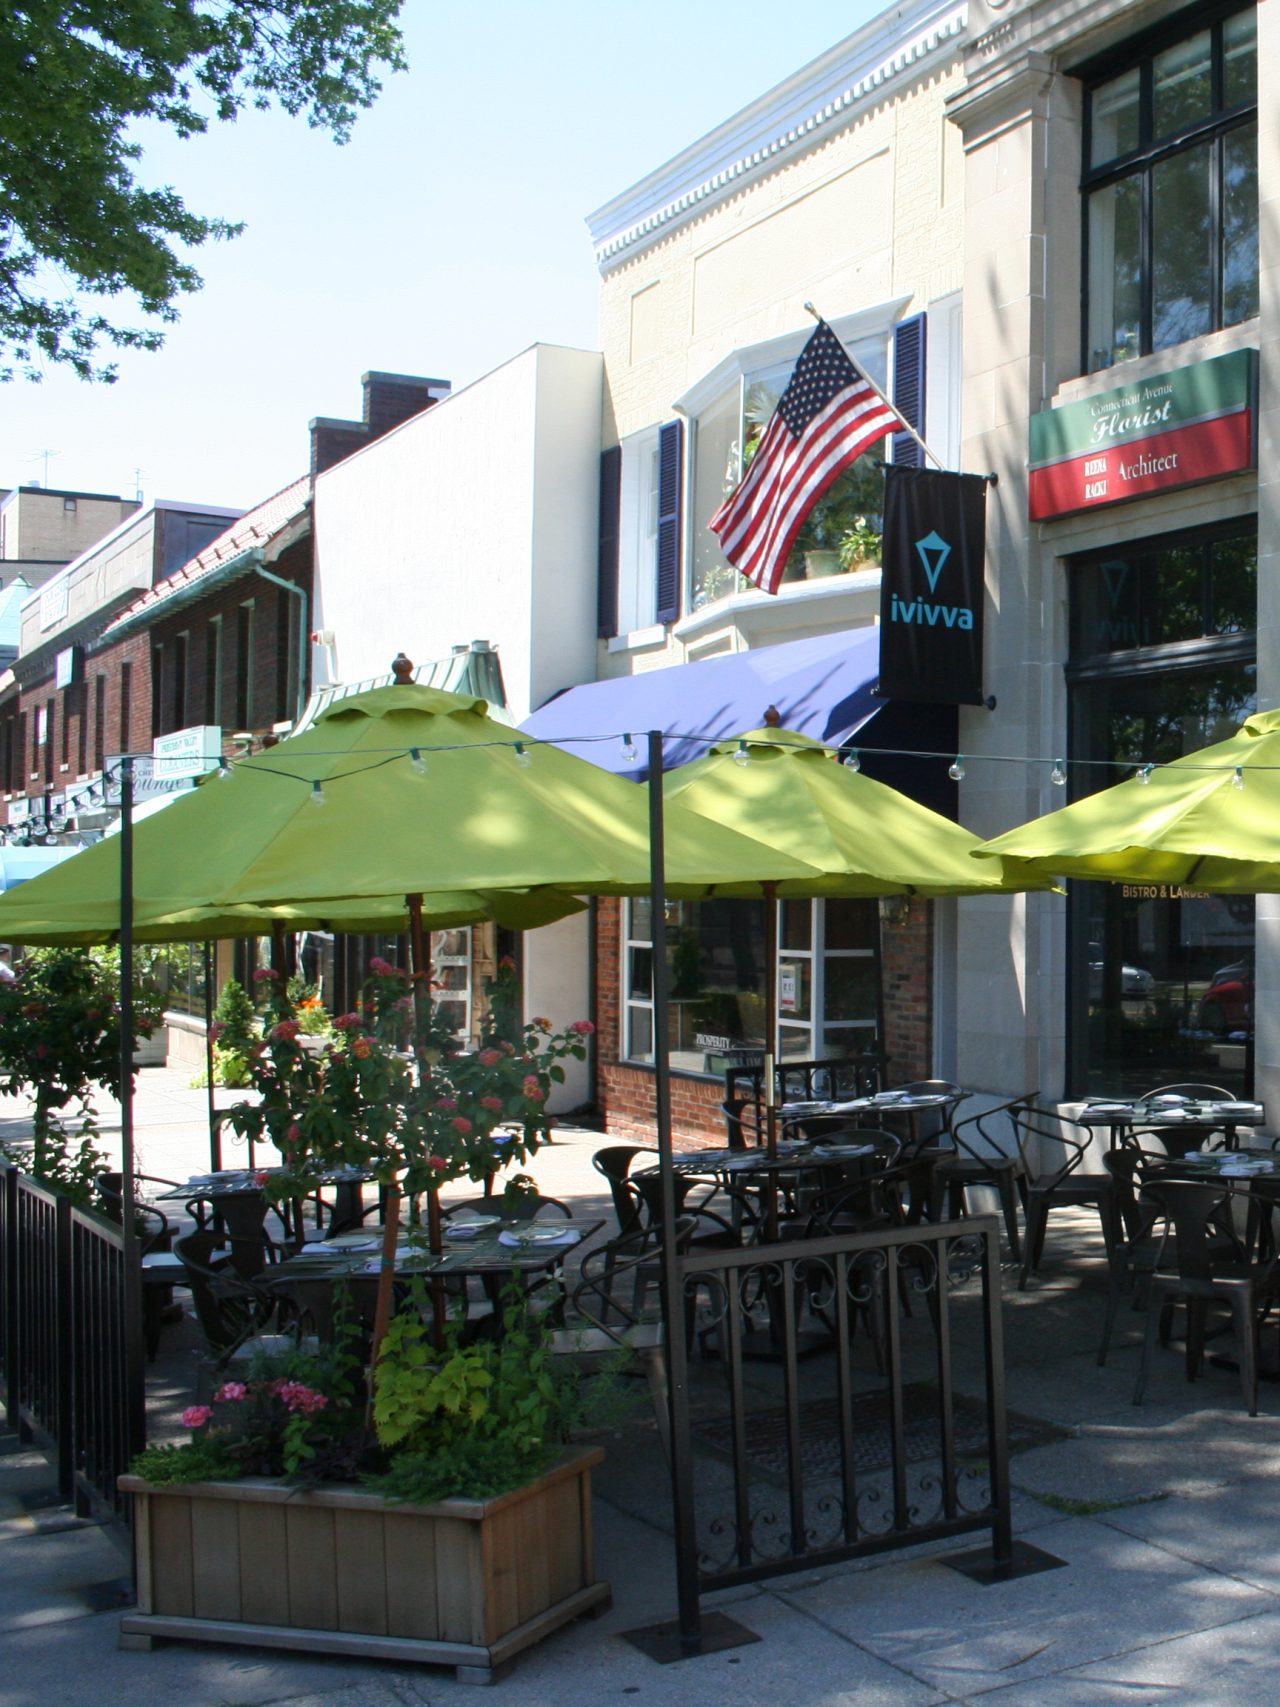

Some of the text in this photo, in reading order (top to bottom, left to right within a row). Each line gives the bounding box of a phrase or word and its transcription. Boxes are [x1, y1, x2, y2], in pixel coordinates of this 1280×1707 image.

[1091, 384, 1173, 416] Connecticut Avenue
[1090, 400, 1172, 443] Florist
[1119, 453, 1178, 480] Architect
[891, 593, 973, 630] ivivva
[1122, 885, 1157, 898] BISTRO
[1160, 885, 1167, 898] &
